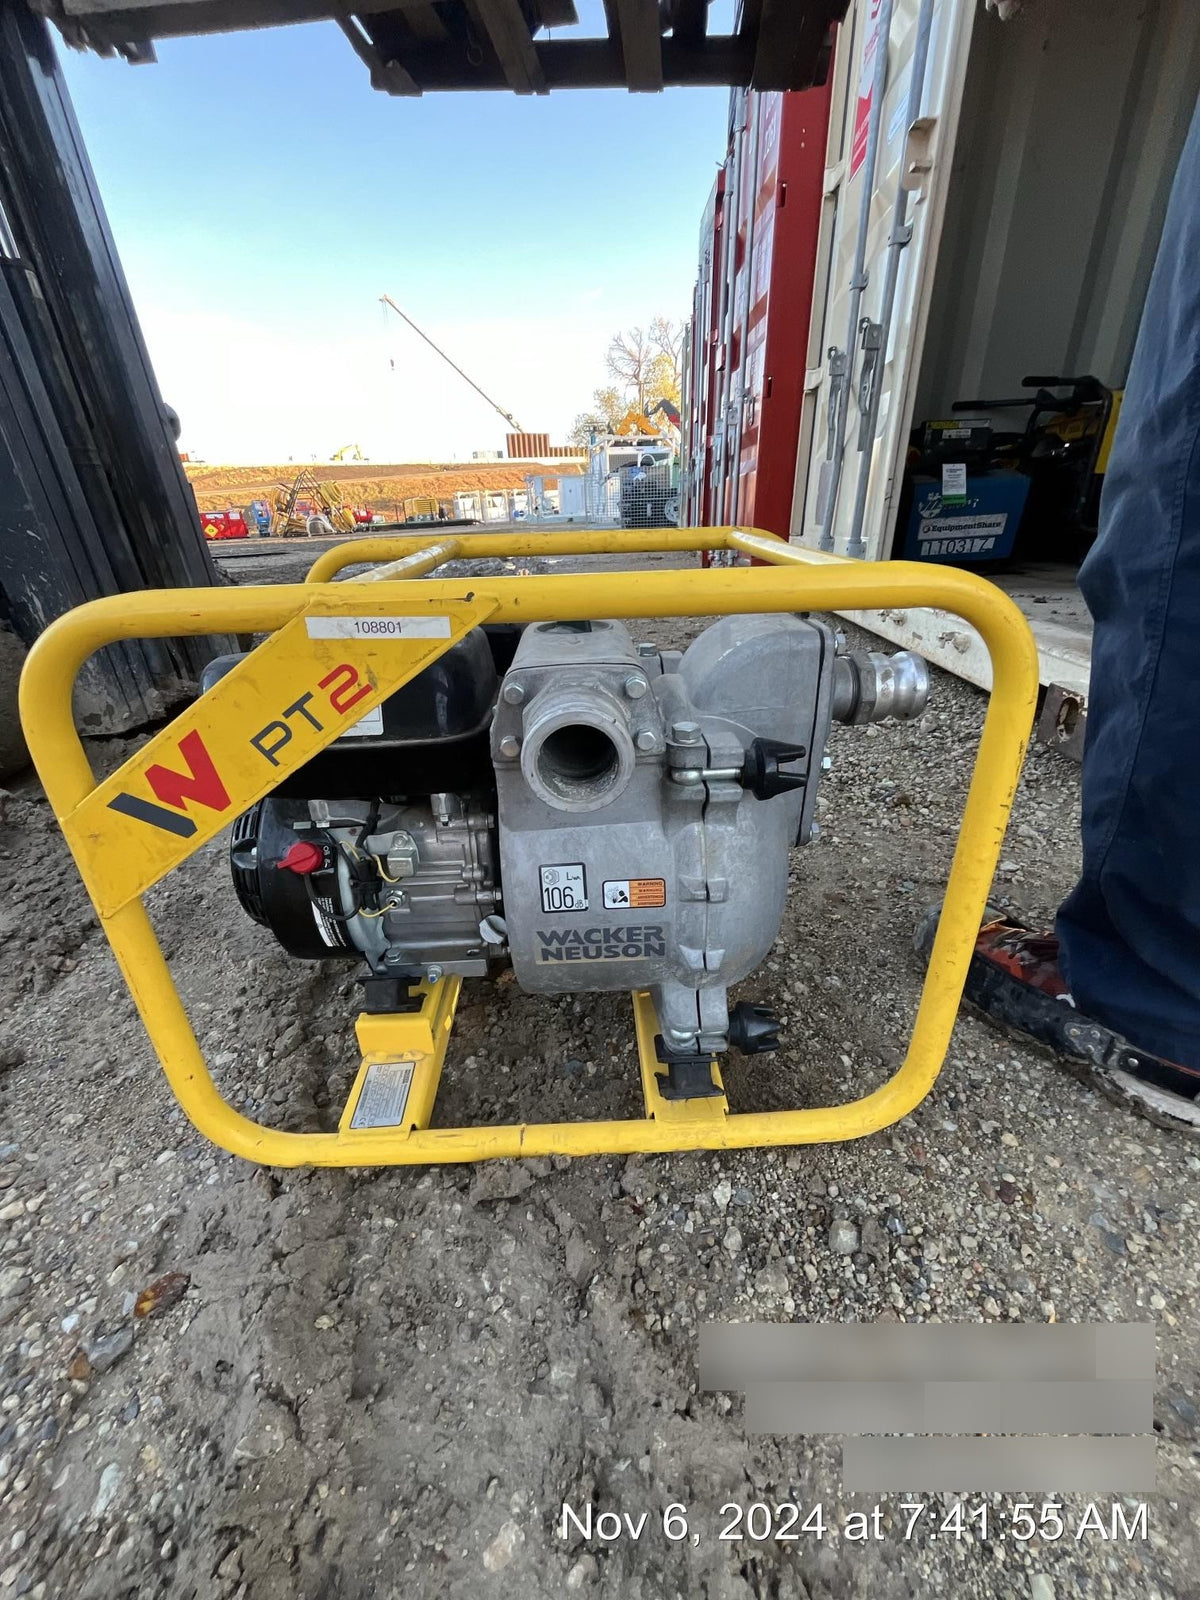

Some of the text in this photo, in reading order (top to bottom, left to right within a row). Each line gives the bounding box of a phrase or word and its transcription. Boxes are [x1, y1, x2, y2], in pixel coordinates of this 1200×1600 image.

[932, 521, 1001, 533] EquipmentShare
[354, 621, 402, 634] 108801
[250, 664, 373, 767] PT2
[544, 886, 574, 910] 106
[536, 925, 666, 947] WACKER
[541, 942, 666, 962] NEUSON
